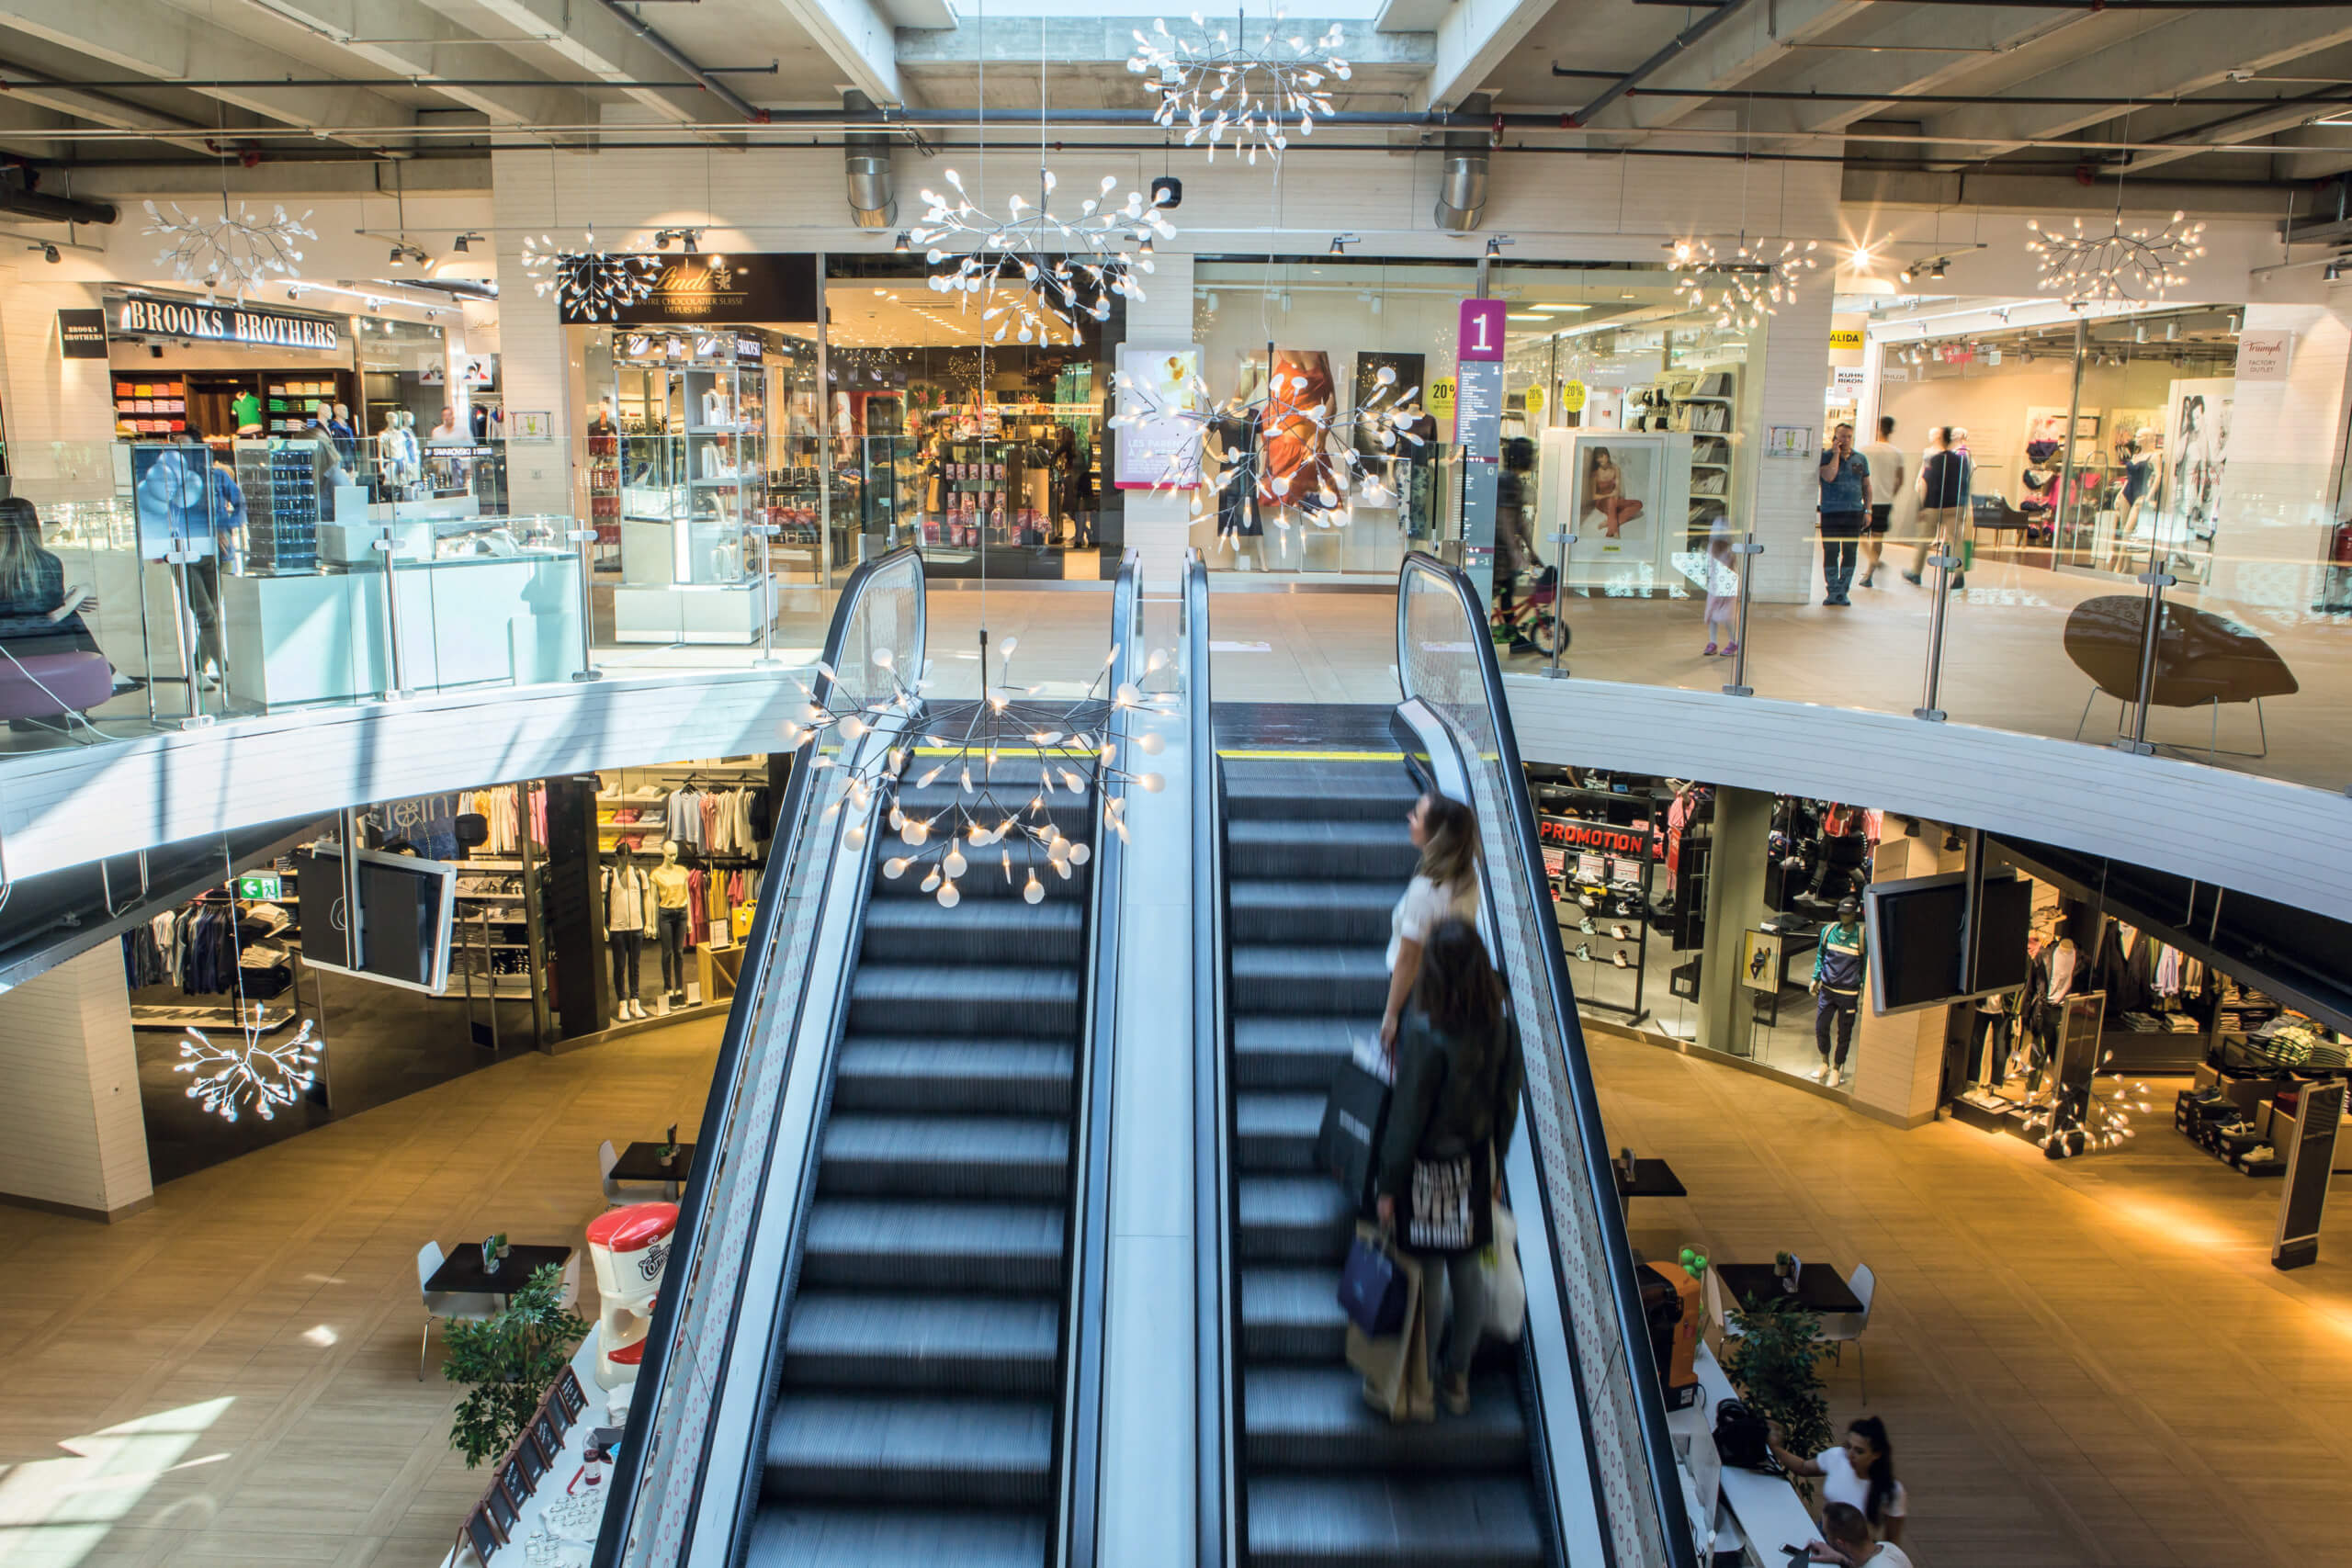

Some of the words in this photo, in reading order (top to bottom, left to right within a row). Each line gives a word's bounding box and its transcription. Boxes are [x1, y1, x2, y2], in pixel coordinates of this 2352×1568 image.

[650, 265, 713, 290] Lindt
[129, 299, 223, 337] BROOKS
[233, 311, 336, 348] BROTHERS
[1472, 313, 1492, 351] 1
[2242, 340, 2283, 355] Triumph
[1493, 366, 1500, 376] 1
[1566, 384, 1583, 397] 20%
[1540, 821, 1643, 853] PROMOTION
